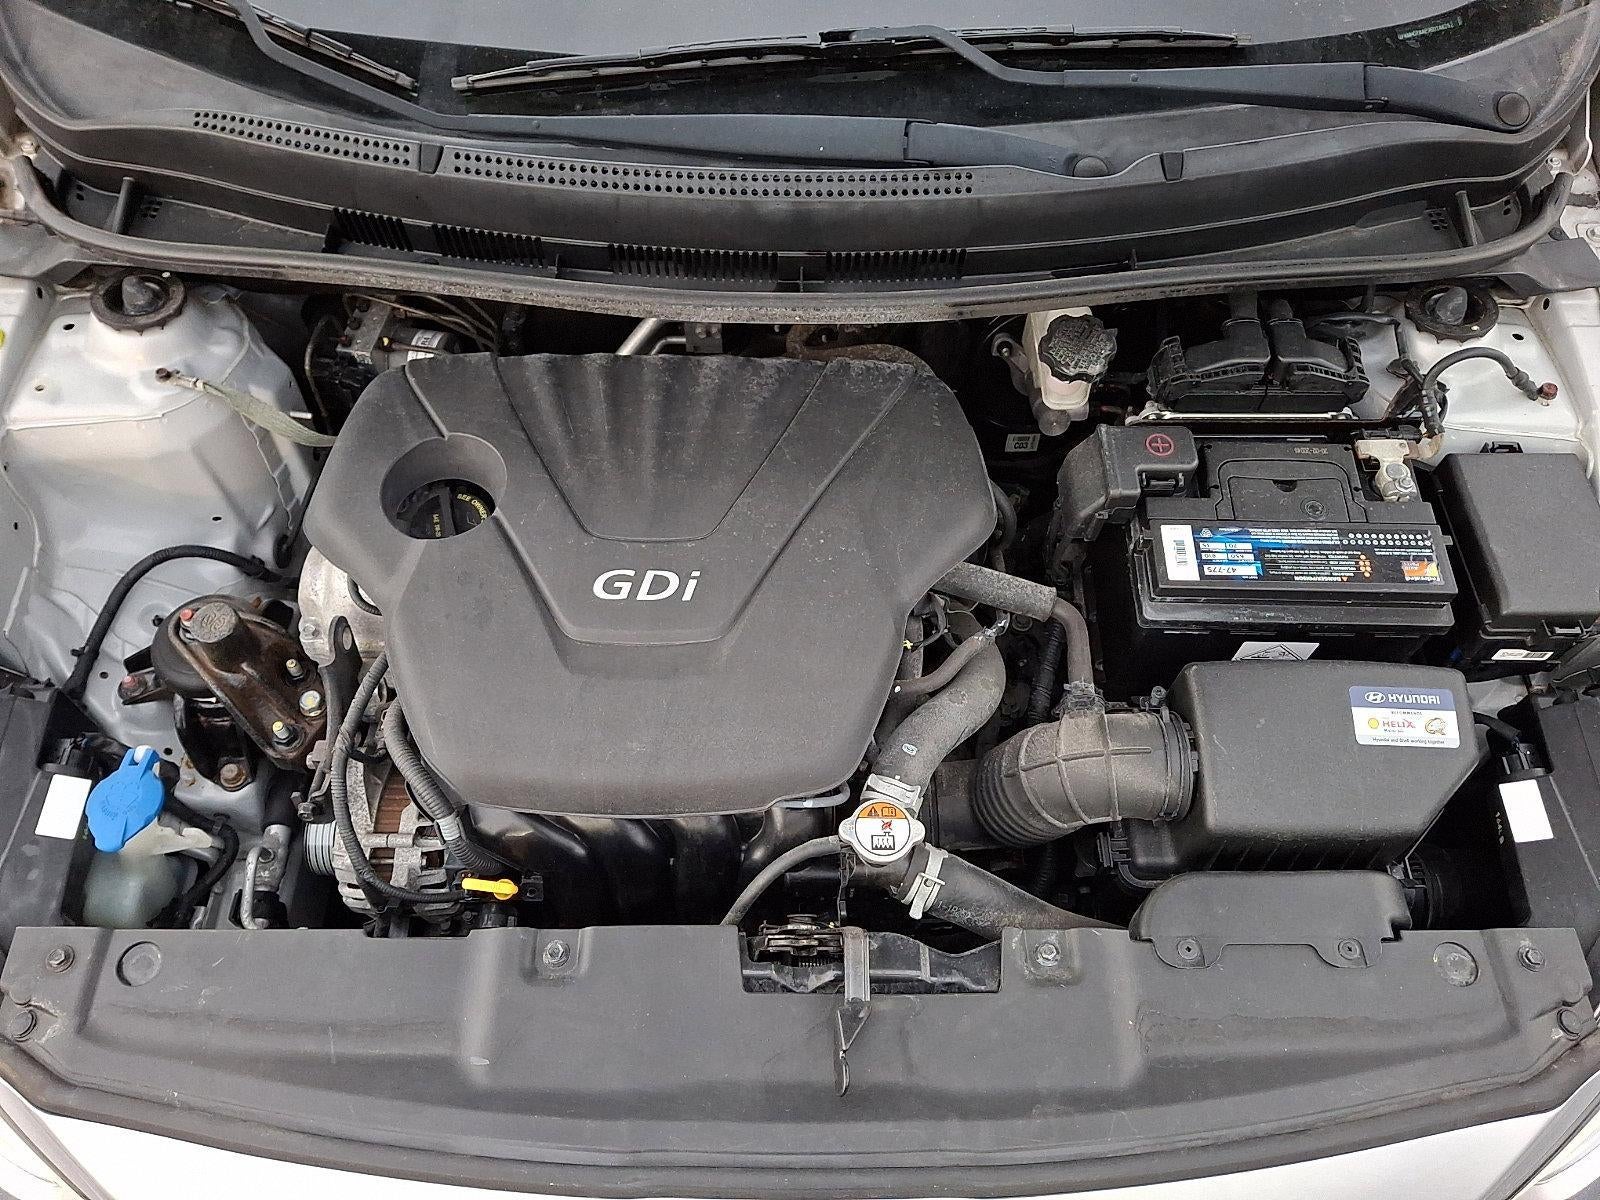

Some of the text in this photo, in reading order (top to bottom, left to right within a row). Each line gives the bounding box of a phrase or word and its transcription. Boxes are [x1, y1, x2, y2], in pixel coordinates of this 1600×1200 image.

[592, 569, 702, 602] GDi
[1388, 693, 1441, 705] HYUNDAI
[1382, 718, 1416, 728] HELIX
